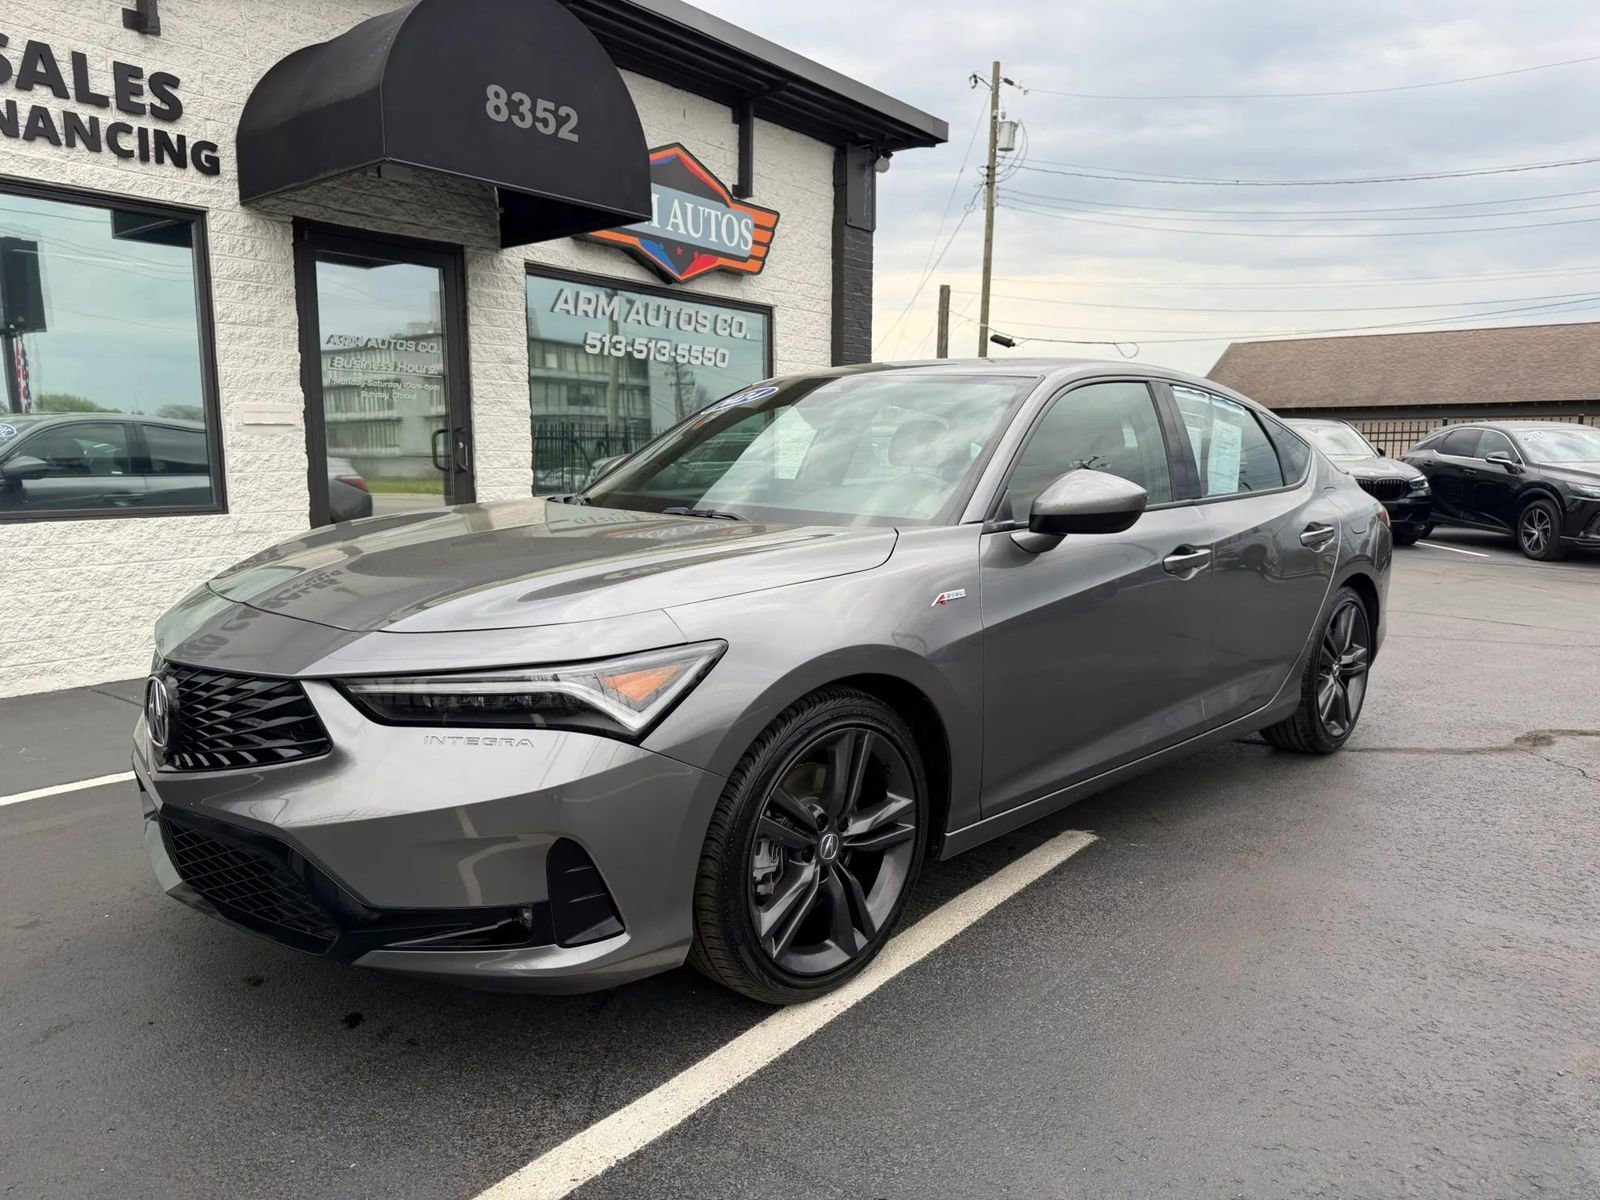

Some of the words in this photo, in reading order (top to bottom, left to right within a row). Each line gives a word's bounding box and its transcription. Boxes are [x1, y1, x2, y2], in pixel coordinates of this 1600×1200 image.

[485, 84, 579, 143] 8352
[666, 198, 753, 251] AUTOS
[552, 288, 621, 321] ARM
[625, 302, 711, 334] AUTOS
[715, 313, 751, 339] CO.
[365, 337, 416, 351] AUTOS
[584, 331, 730, 368] 513-513-5550
[423, 735, 535, 748] INTEGRA
